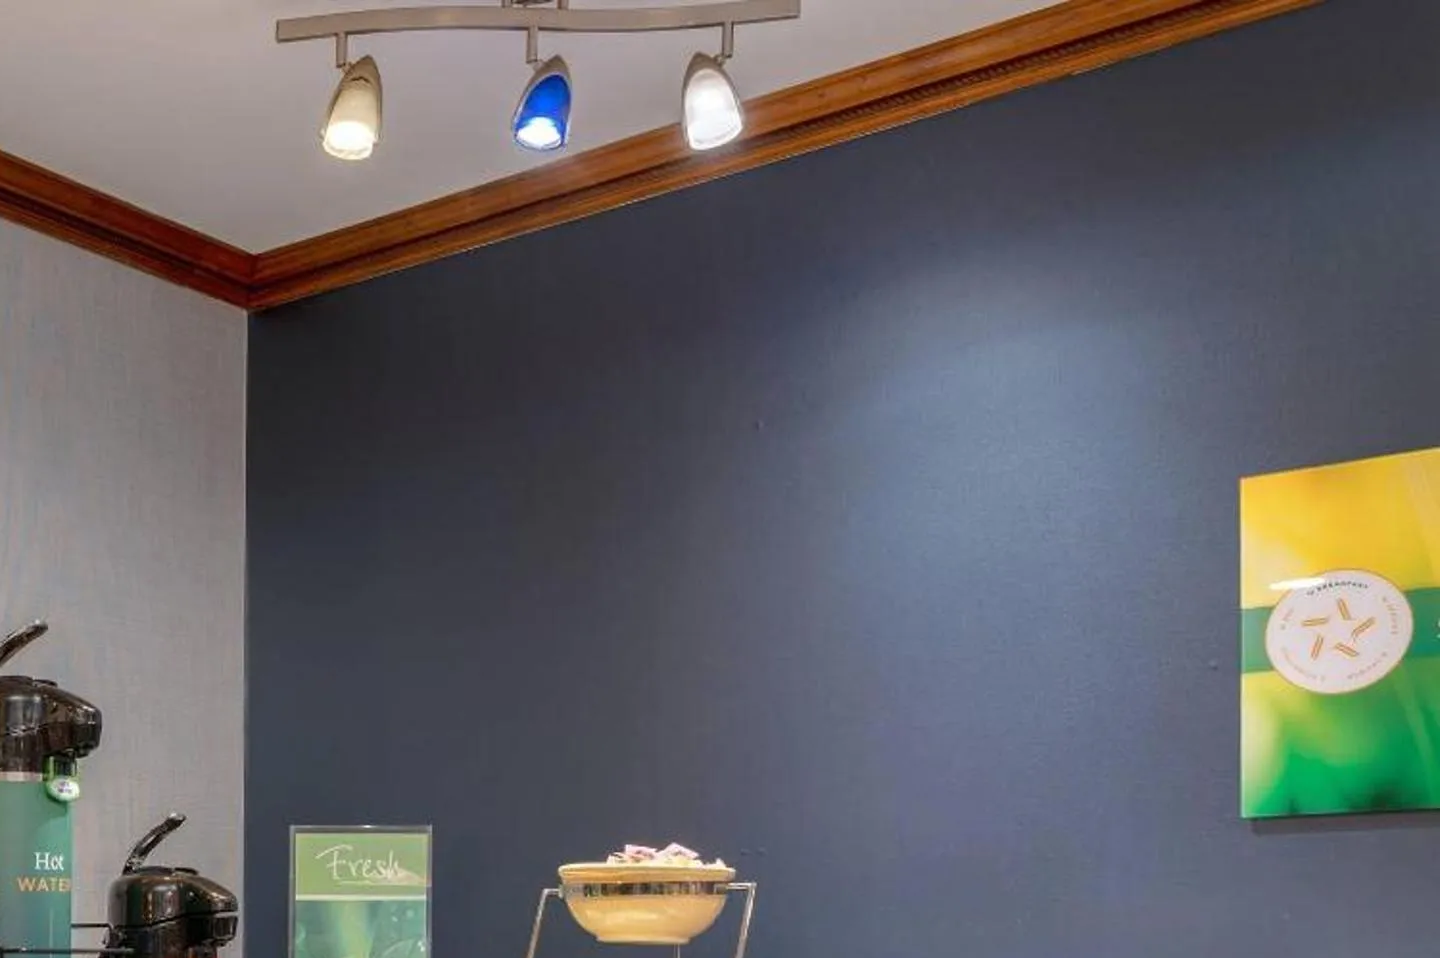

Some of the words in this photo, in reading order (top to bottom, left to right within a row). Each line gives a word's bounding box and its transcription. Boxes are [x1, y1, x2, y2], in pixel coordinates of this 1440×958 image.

[34, 851, 64, 870] Hot
[315, 844, 401, 880] Fresh
[16, 877, 71, 892] WATE
